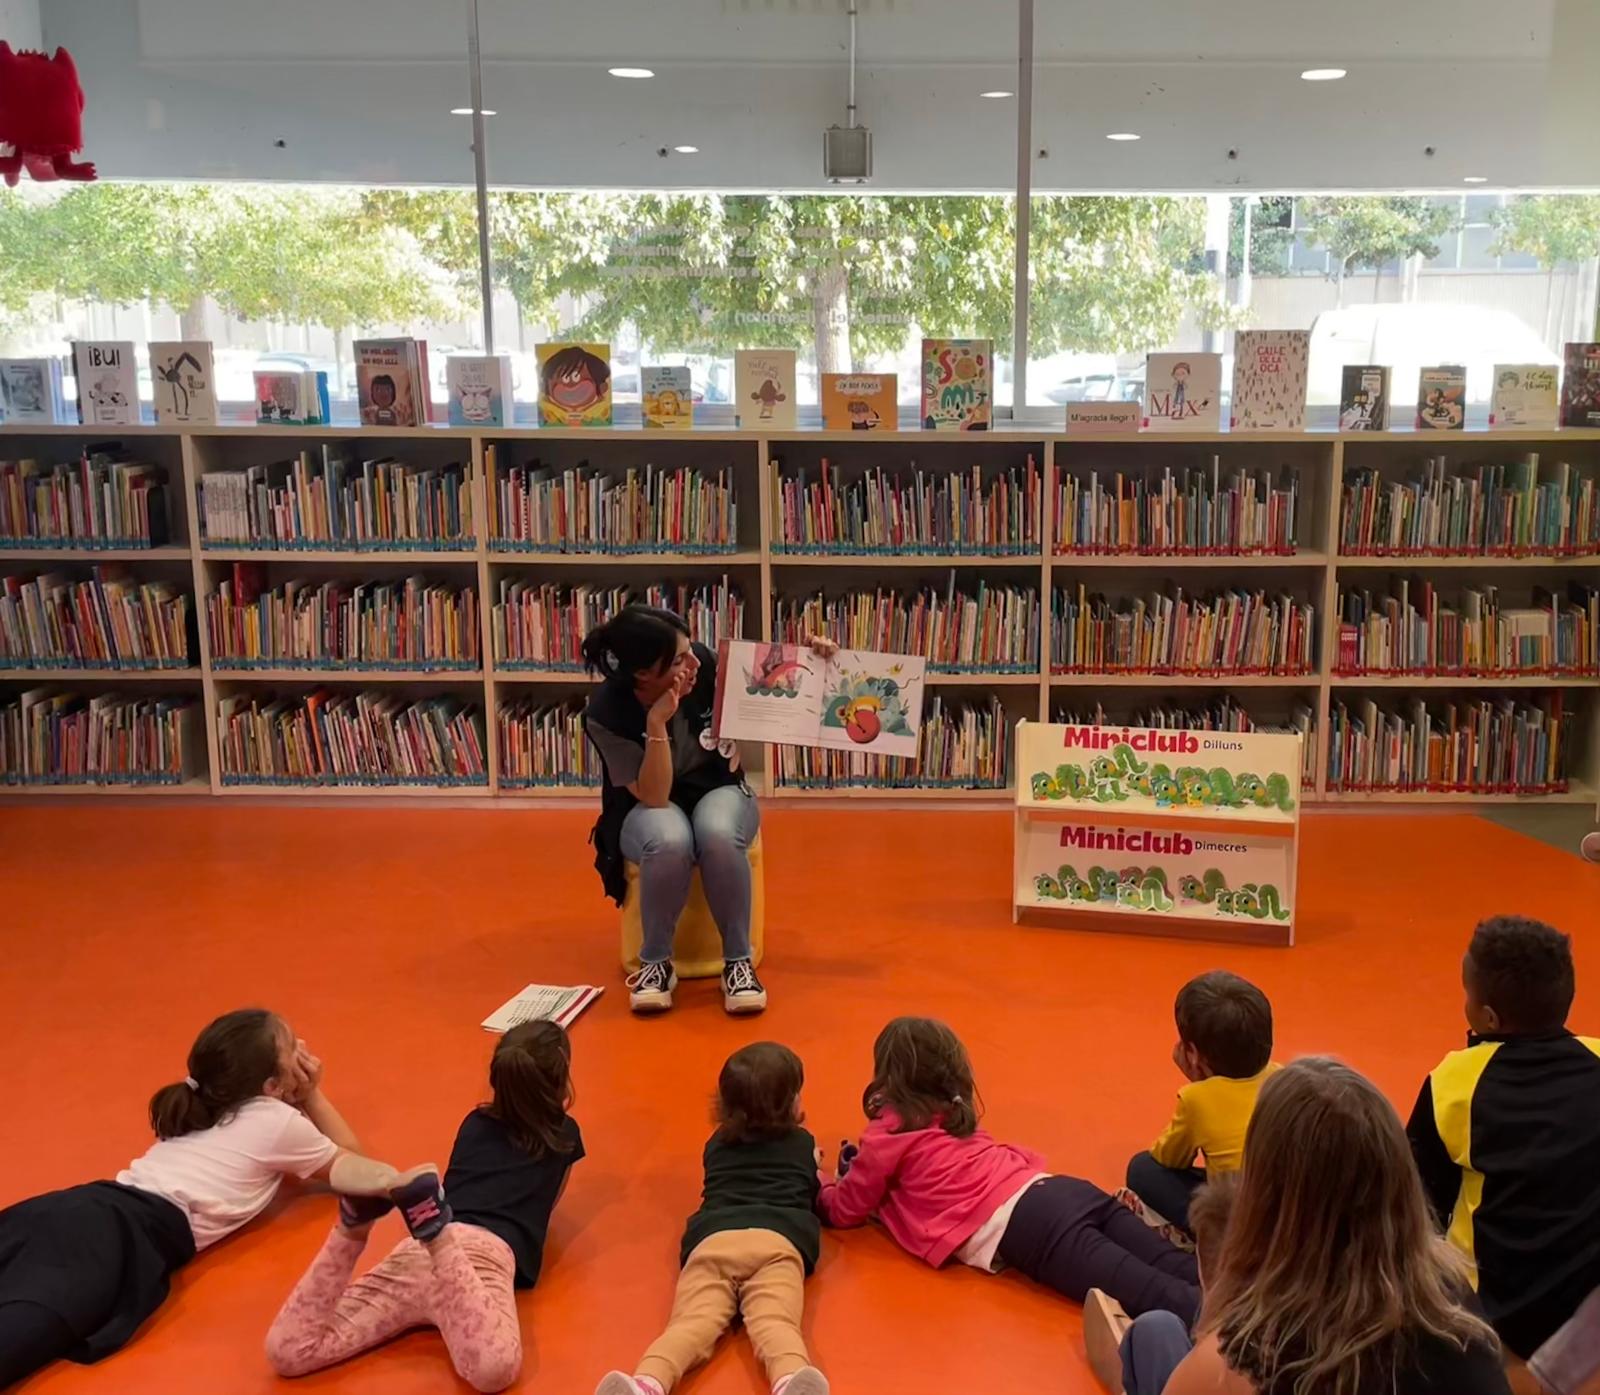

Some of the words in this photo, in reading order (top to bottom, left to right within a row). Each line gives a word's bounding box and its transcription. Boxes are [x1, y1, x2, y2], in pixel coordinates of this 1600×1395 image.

[1063, 726, 1200, 754] Miniclub
[1202, 739, 1244, 752] Dilluns
[1059, 825, 1194, 856] Miniclub
[1194, 840, 1249, 853] Dimecres
